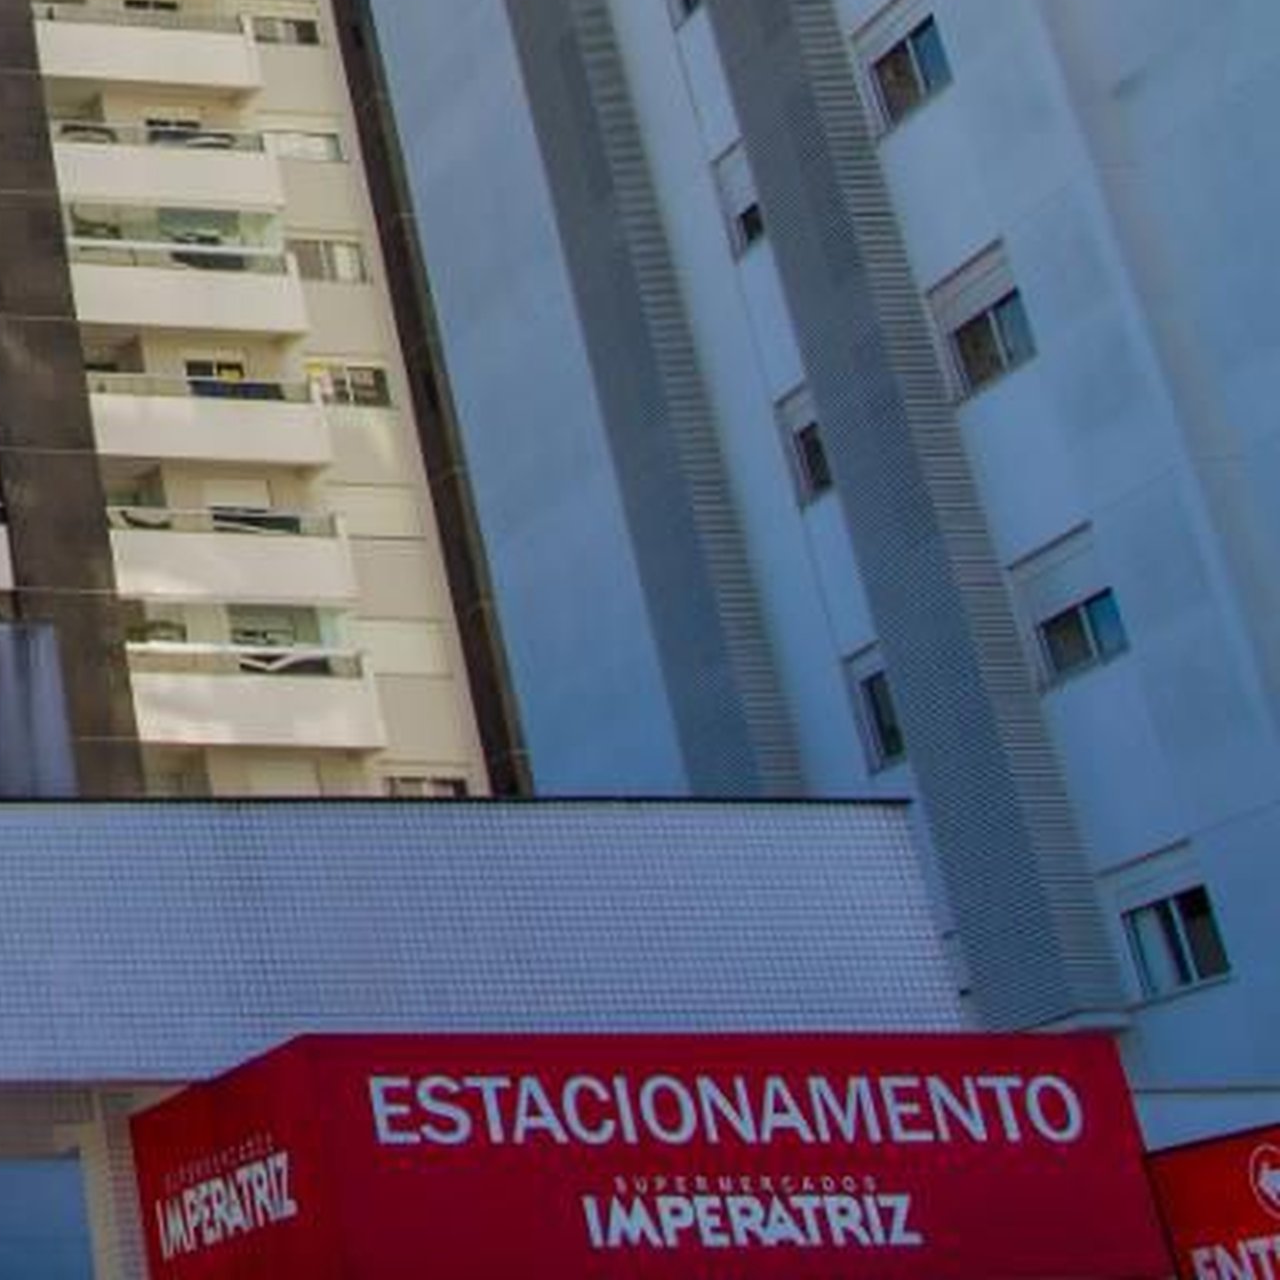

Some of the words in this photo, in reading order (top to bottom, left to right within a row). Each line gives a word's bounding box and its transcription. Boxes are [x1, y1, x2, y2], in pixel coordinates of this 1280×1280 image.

[368, 1074, 1085, 1146] ESTACIONAMENTO
[154, 1150, 298, 1262] IMPERATRIZ
[613, 1174, 879, 1195] SUPERMERCADOS
[582, 1193, 925, 1249] IMPERATRIZ
